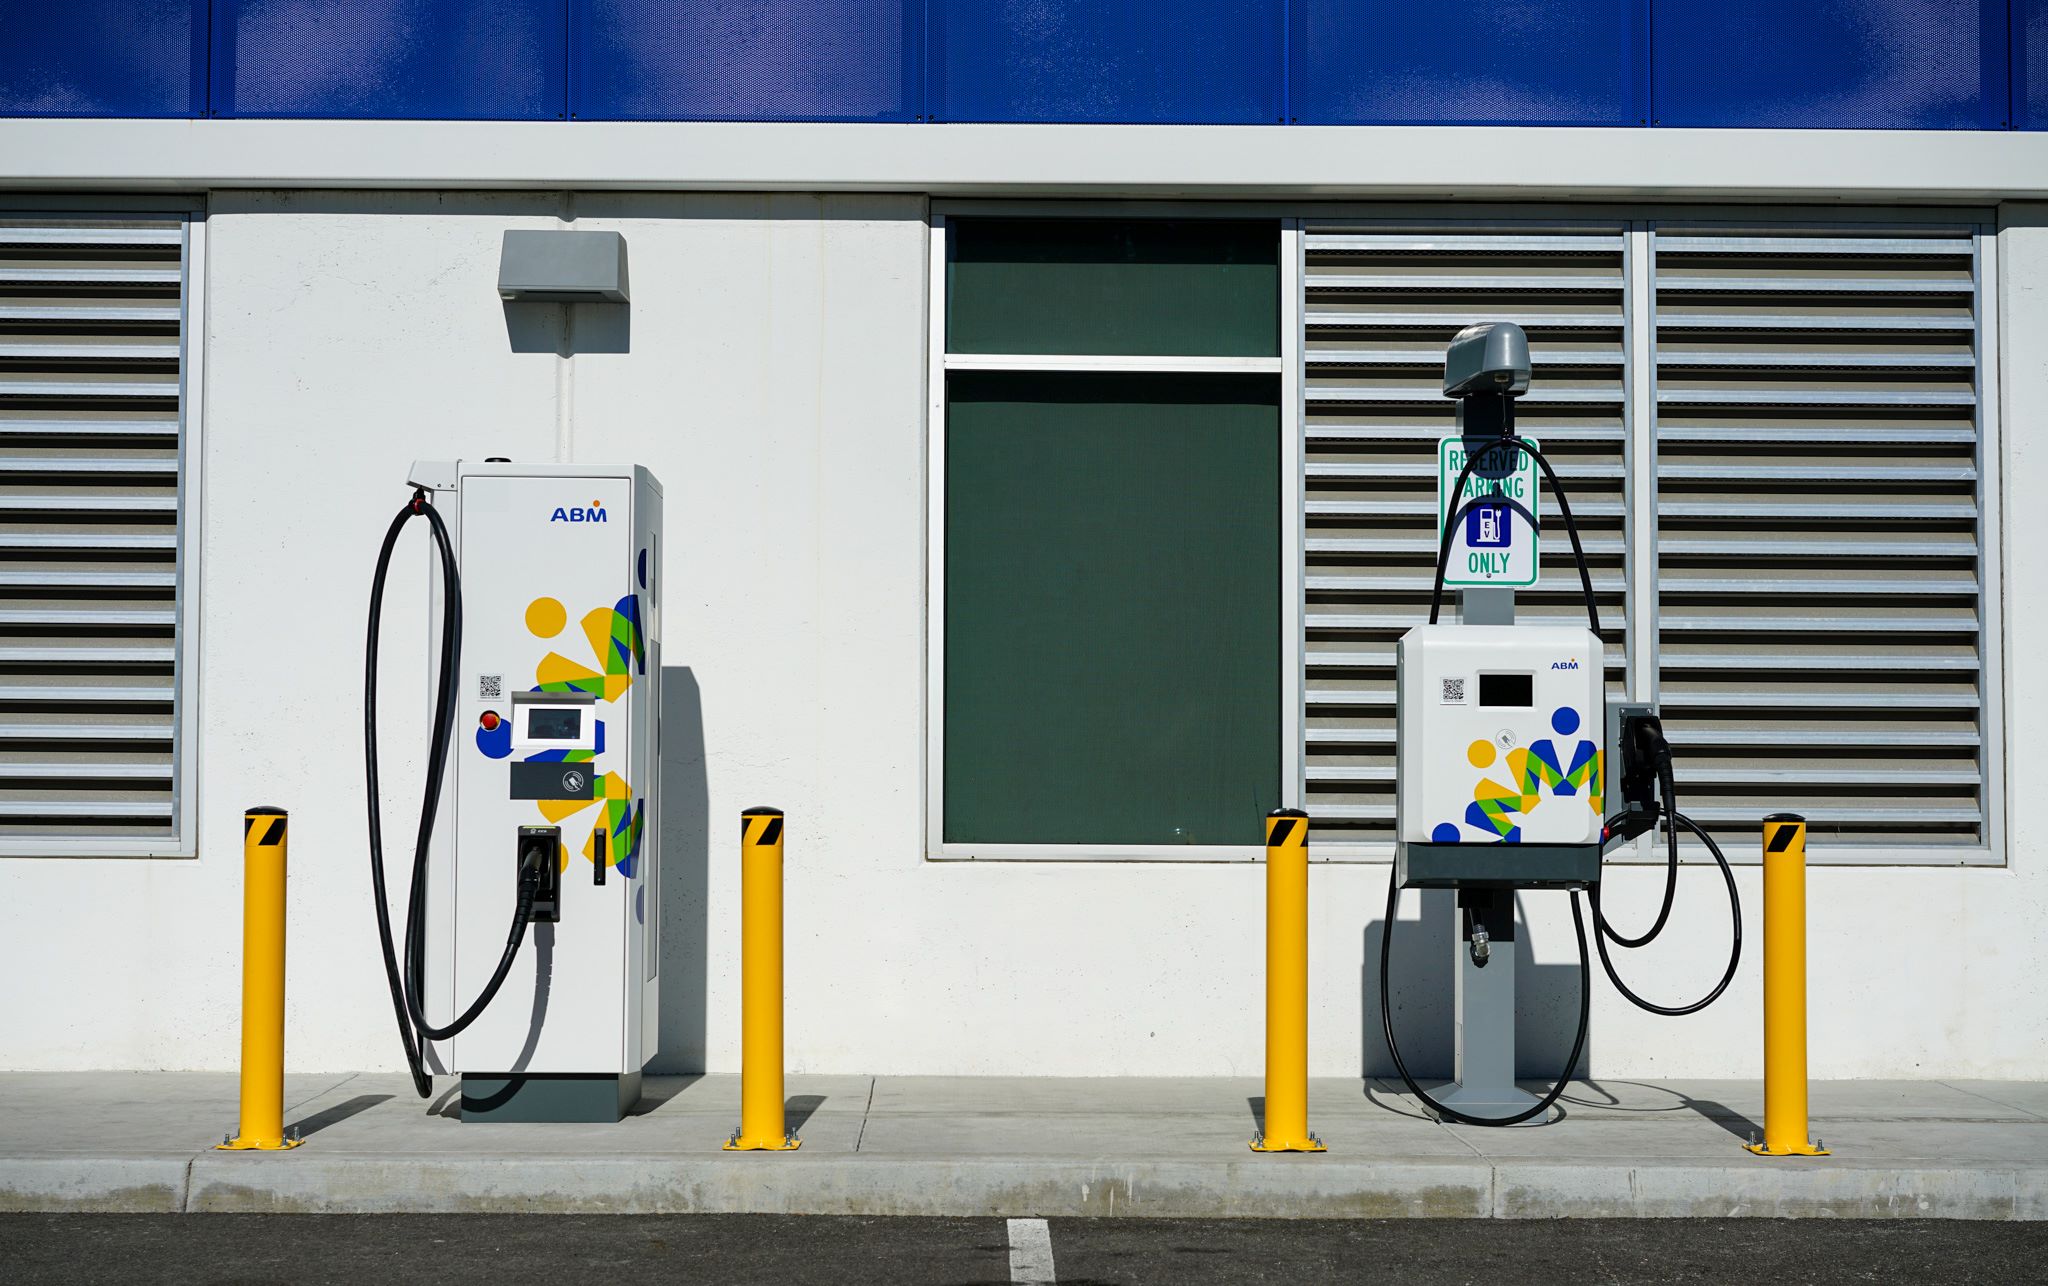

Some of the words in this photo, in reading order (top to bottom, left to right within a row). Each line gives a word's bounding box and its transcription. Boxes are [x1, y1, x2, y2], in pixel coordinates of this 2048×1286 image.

[1454, 477, 1524, 498] ARKING
[550, 507, 608, 522] ABM
[1468, 552, 1511, 573] ONLY
[1551, 661, 1579, 670] ABM
